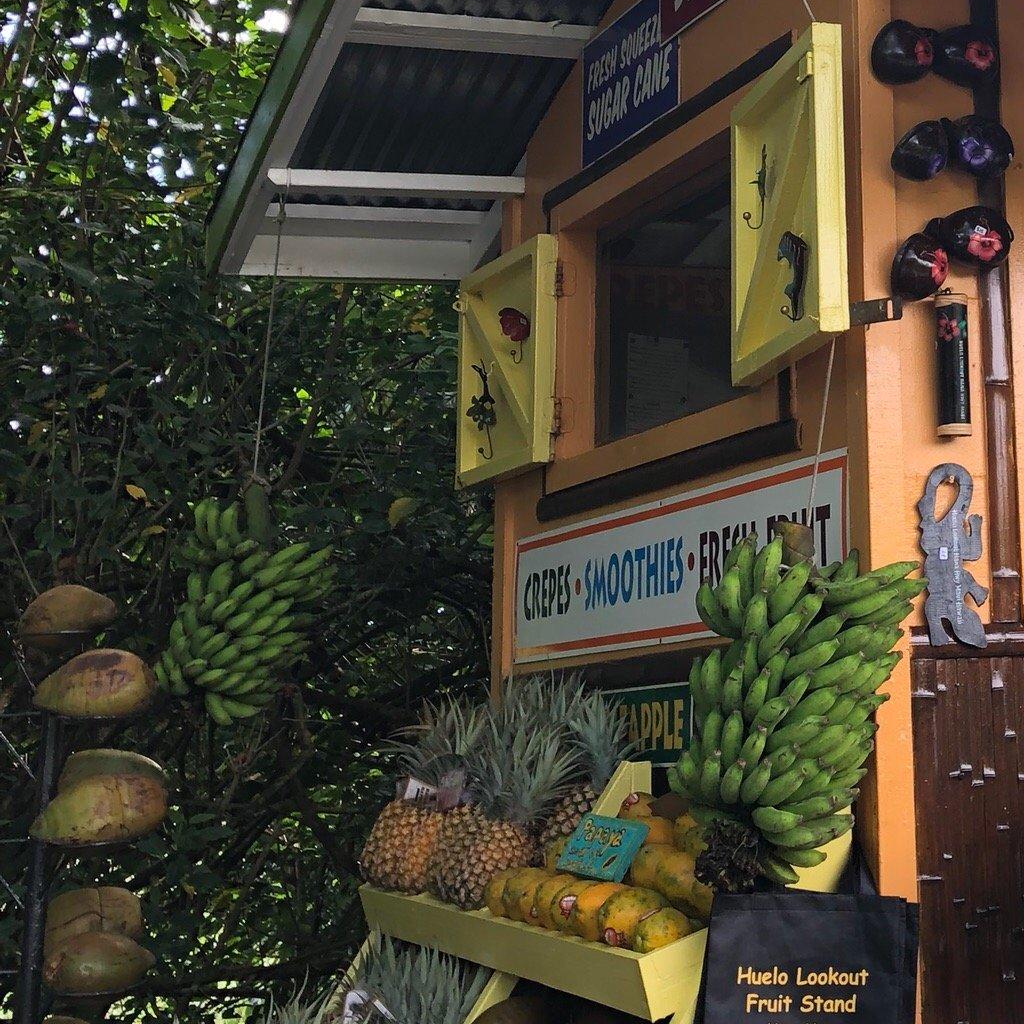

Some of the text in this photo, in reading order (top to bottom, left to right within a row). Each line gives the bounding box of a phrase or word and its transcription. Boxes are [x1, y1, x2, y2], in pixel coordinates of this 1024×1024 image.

[587, 43, 672, 141] SUGAR CANE
[588, 45, 618, 94] FRESH
[524, 563, 572, 621] CREPES
[584, 534, 684, 612] SMOOTHIES
[737, 966, 869, 986] Huelo Lookout
[746, 993, 857, 1013] Fruit Stand
